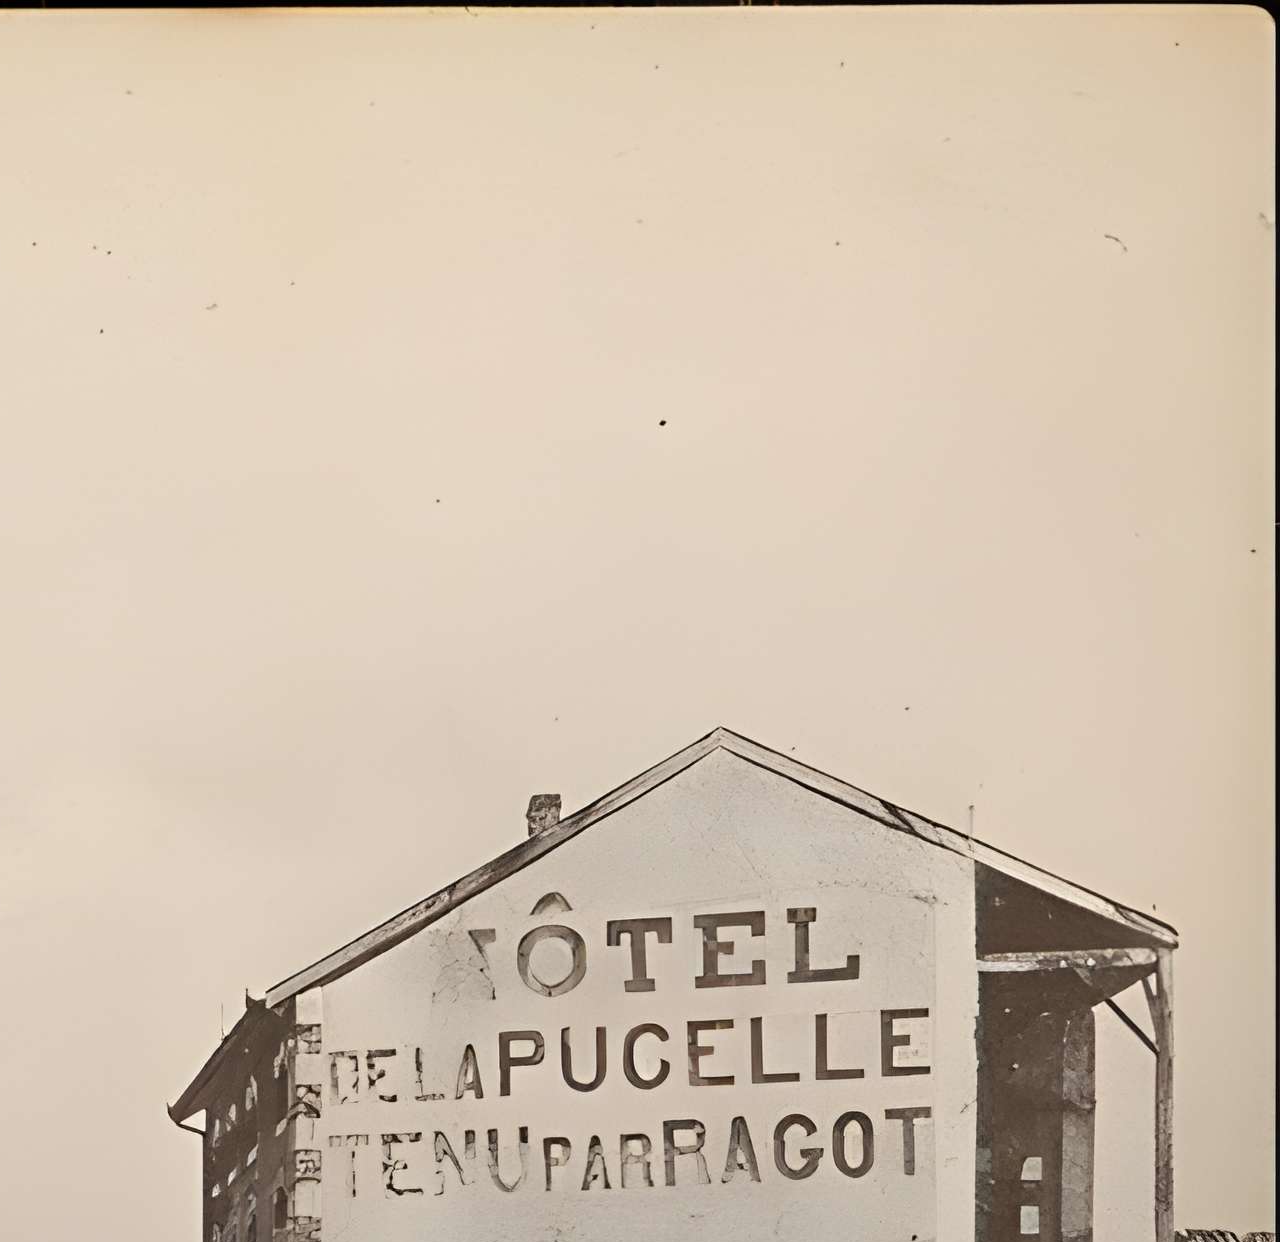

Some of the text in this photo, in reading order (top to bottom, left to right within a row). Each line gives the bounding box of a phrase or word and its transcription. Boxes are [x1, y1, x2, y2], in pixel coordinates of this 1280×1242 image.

[467, 891, 860, 1000] ÔTEL
[414, 1044, 485, 1100] LA
[498, 1007, 931, 1097] PUCELLE
[542, 1132, 654, 1192] PAR
[663, 1106, 932, 1188] RAGOT
